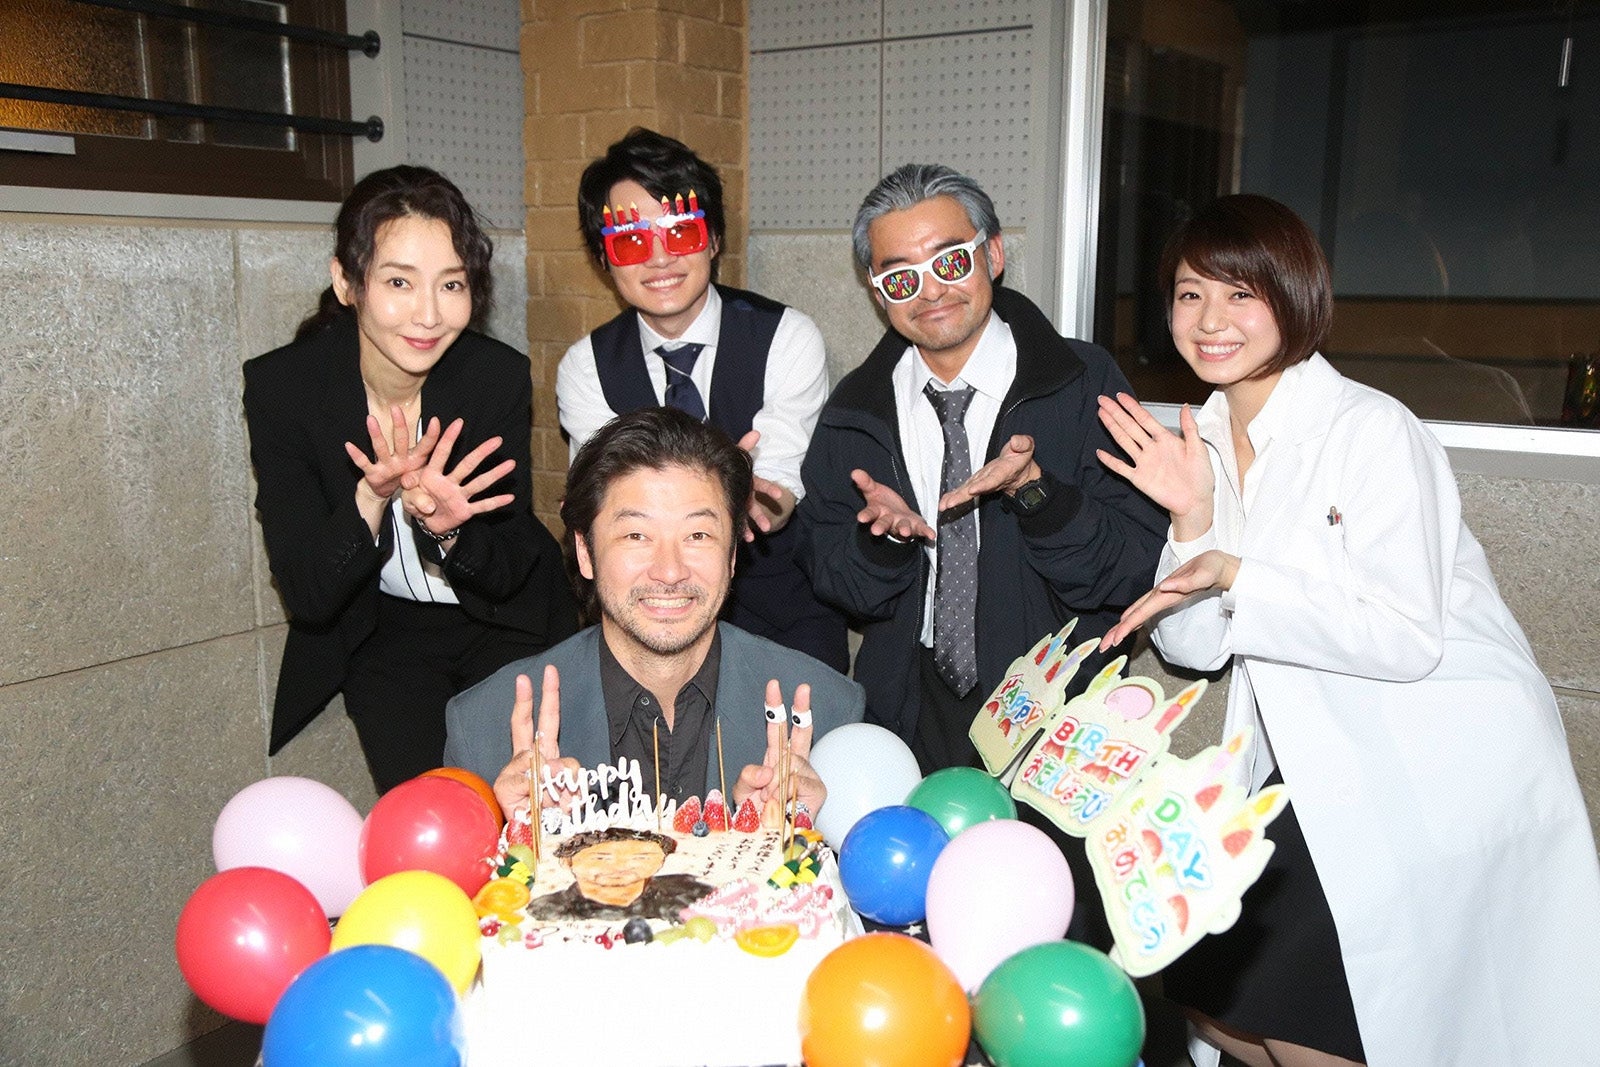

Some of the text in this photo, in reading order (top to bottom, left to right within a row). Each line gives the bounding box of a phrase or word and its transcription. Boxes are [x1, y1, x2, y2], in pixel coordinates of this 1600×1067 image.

[934, 249, 966, 268] HAPPY
[938, 258, 967, 276] BIRTH
[883, 270, 914, 286] HAPPY
[946, 266, 966, 281] DAY
[887, 278, 917, 293] BIRTH
[894, 286, 913, 298] DAY
[997, 674, 1044, 729] HAPPY
[1051, 717, 1146, 778] BIRTH
[1023, 754, 1110, 821] おたんじょうび
[1150, 793, 1211, 887] DAY
[1104, 819, 1167, 952] おめでとう
